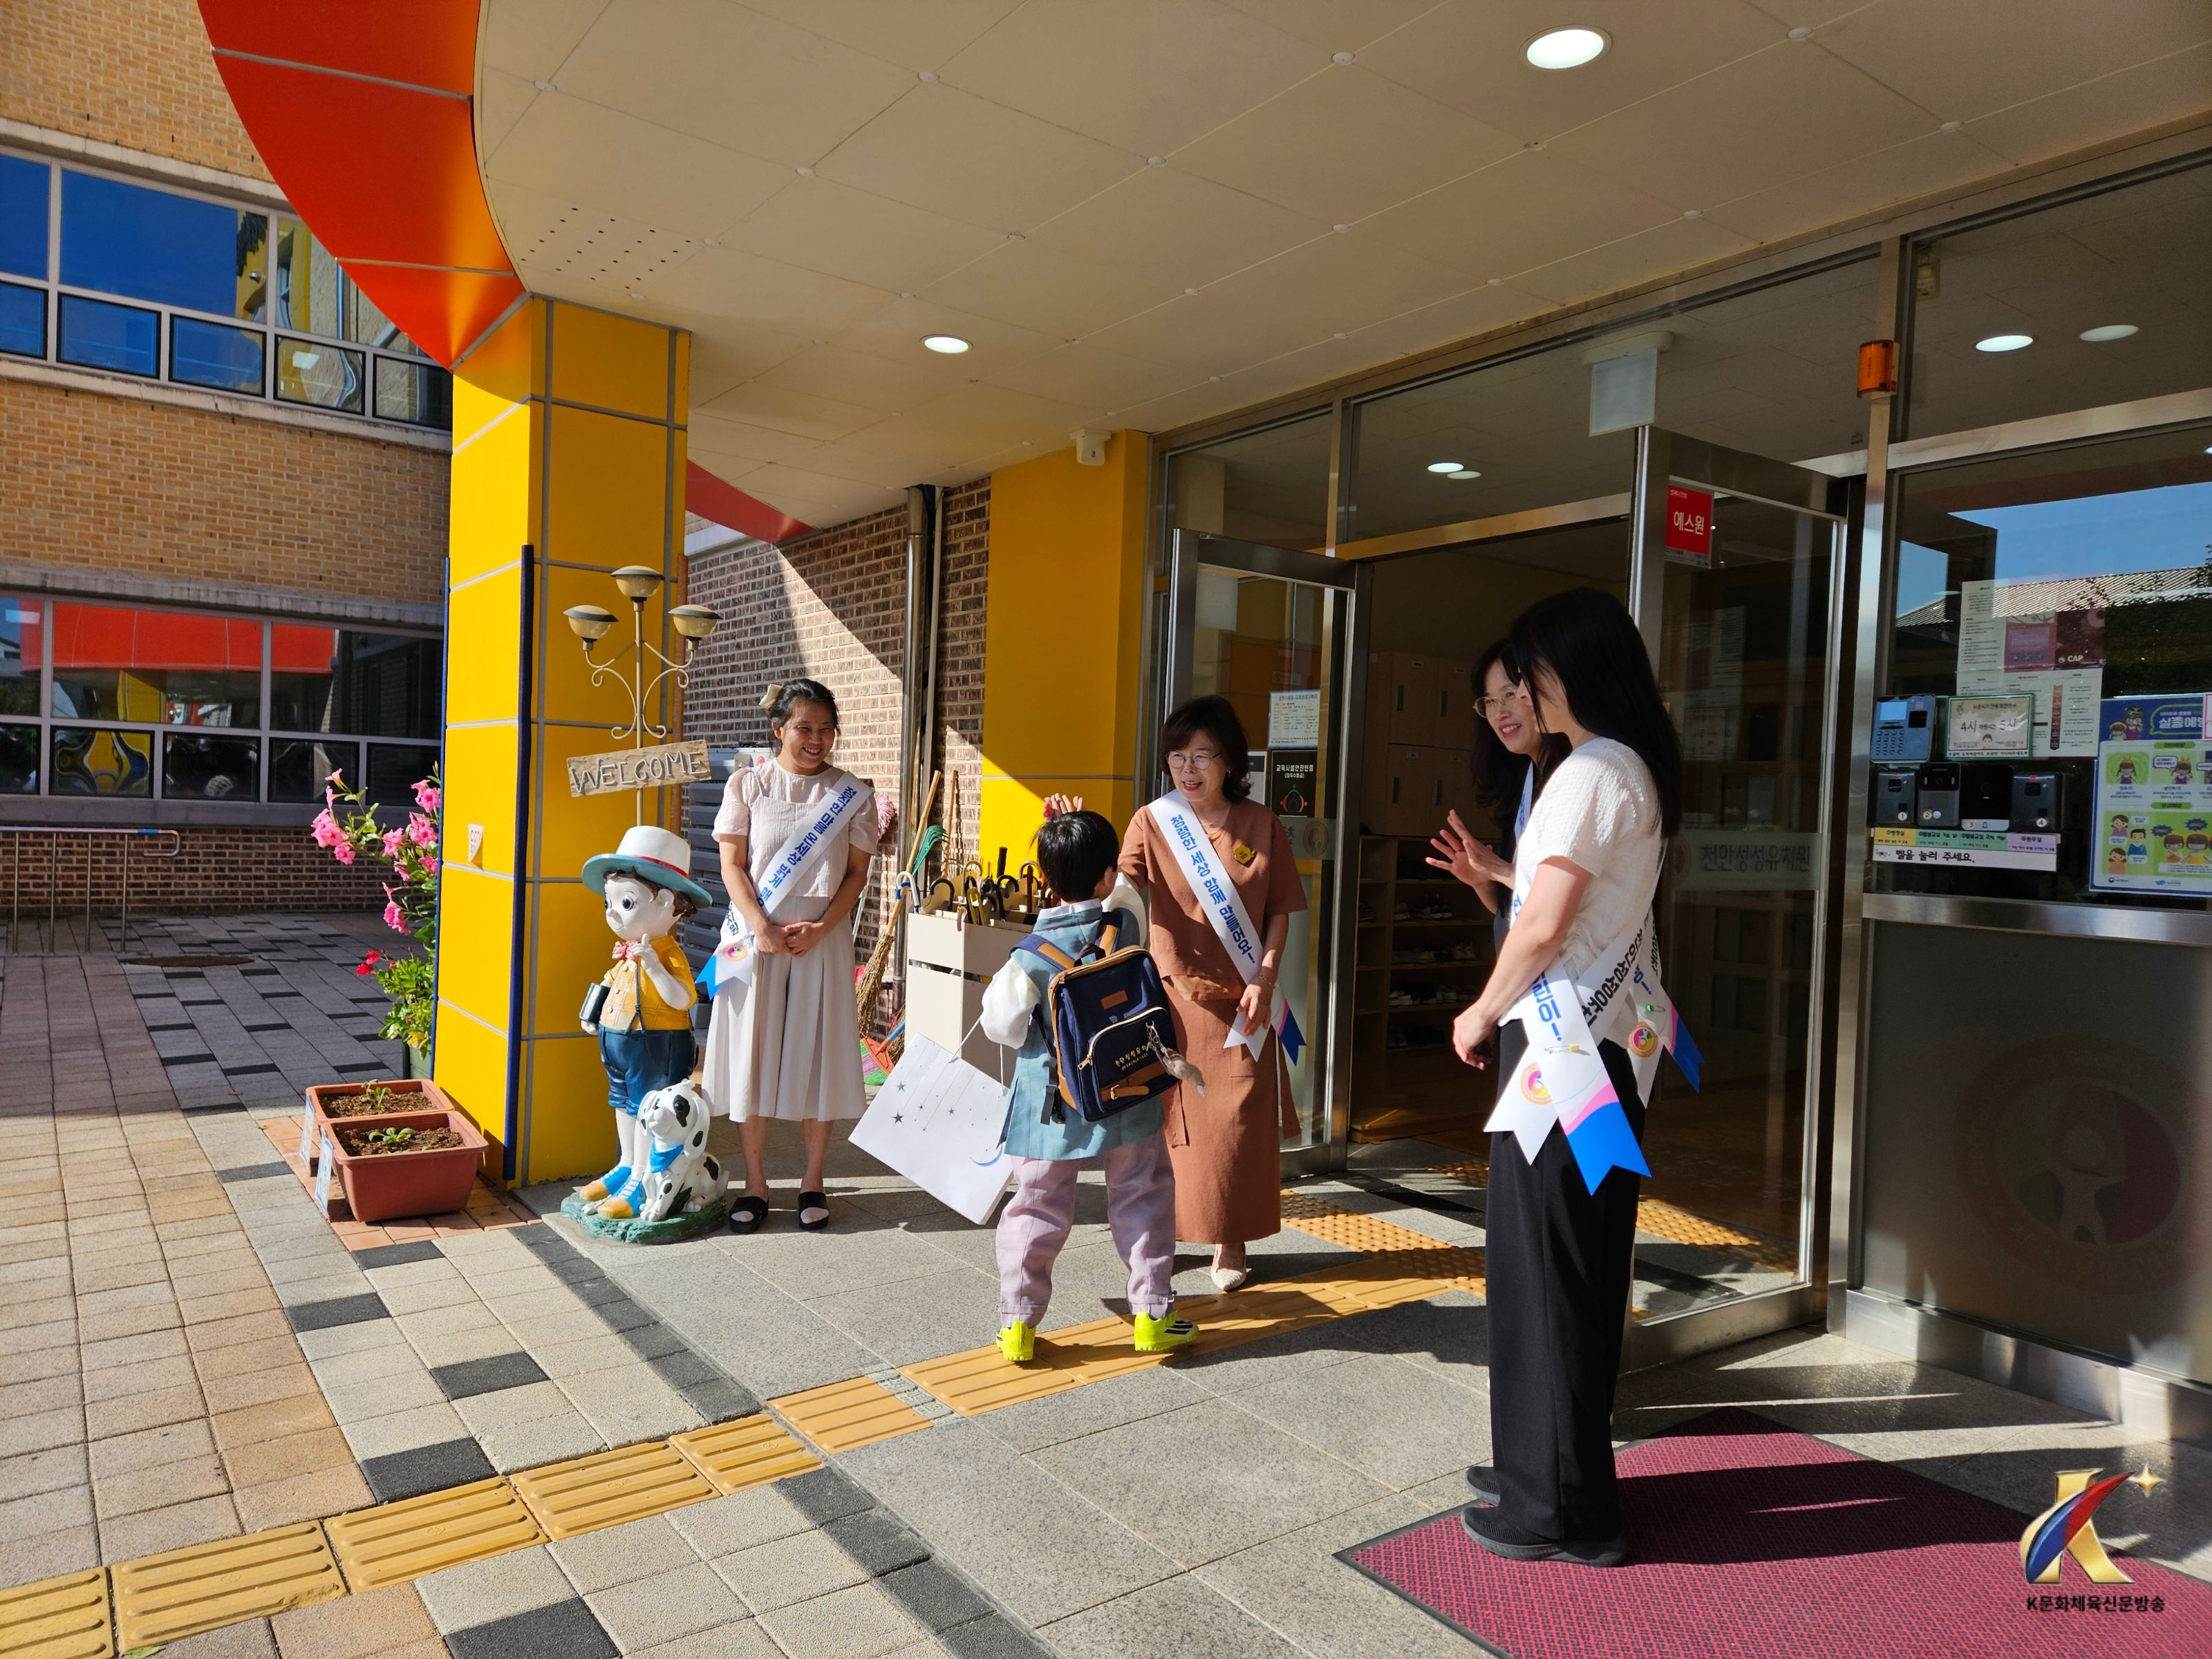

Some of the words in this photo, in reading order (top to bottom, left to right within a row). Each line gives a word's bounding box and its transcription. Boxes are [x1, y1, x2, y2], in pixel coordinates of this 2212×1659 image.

[1674, 511, 1705, 535] 에스원
[2067, 655, 2084, 663] CAP
[1960, 720, 1977, 733] 4시
[570, 751, 709, 794] WELCOME
[1276, 764, 1314, 772] 교육시설안전인증
[830, 786, 857, 818] 정직한
[815, 812, 834, 835] 마음
[1170, 814, 1196, 850] 청렴한
[1190, 853, 1211, 877] 세상
[1203, 877, 1227, 905] 함께
[1701, 844, 1811, 872] 천안성성유치원
[1895, 849, 1914, 861] 벨을
[1918, 850, 1938, 861] 눌러
[1942, 851, 1975, 863] 주세요.
[768, 863, 791, 889] 밝게
